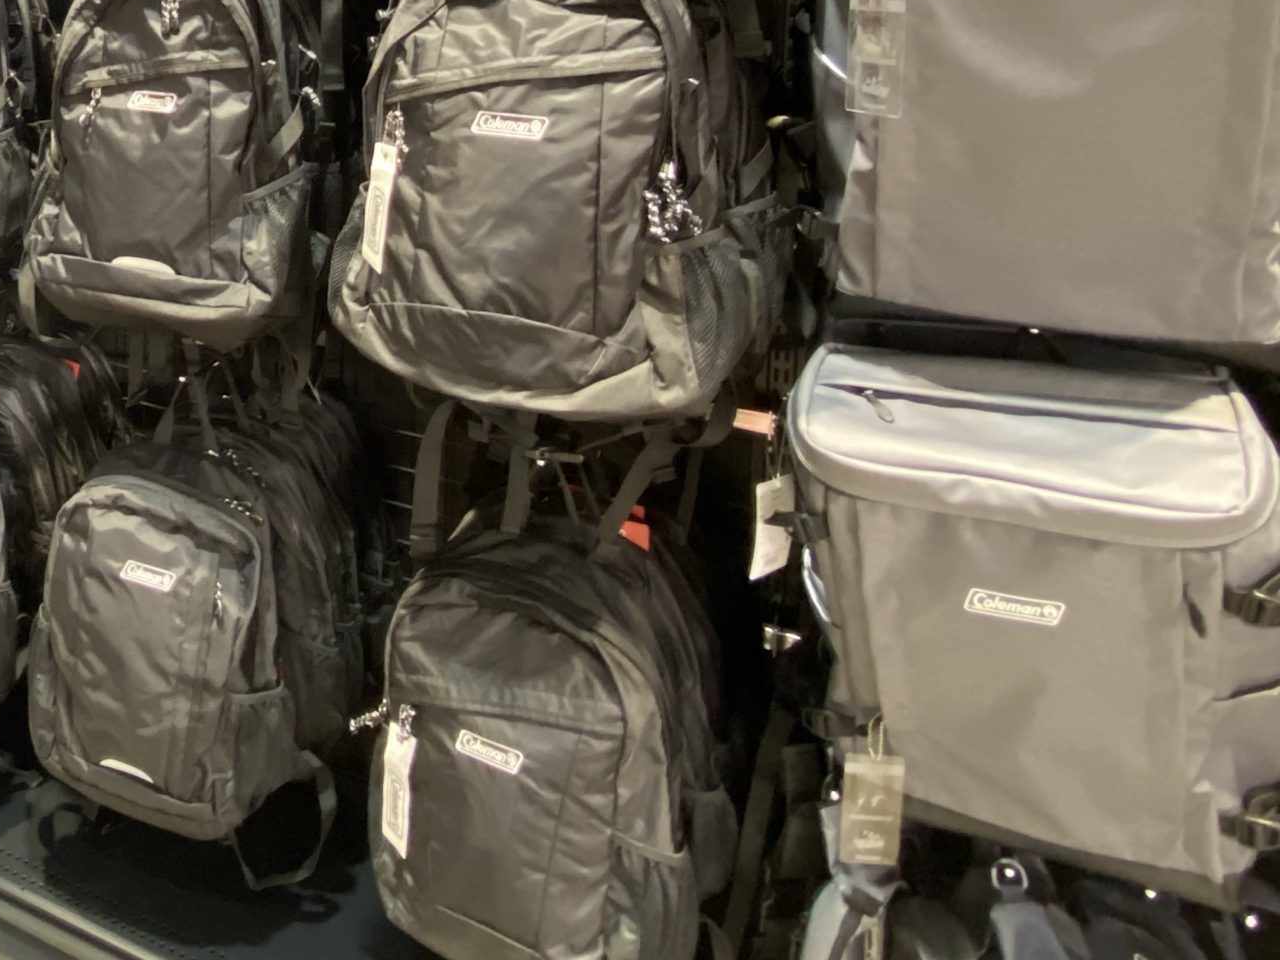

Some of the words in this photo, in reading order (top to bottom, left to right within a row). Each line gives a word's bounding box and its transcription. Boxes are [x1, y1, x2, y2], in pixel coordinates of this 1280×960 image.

[480, 114, 530, 132] Coleman
[973, 593, 1041, 617] Coleman
[462, 735, 507, 761] Coleman
